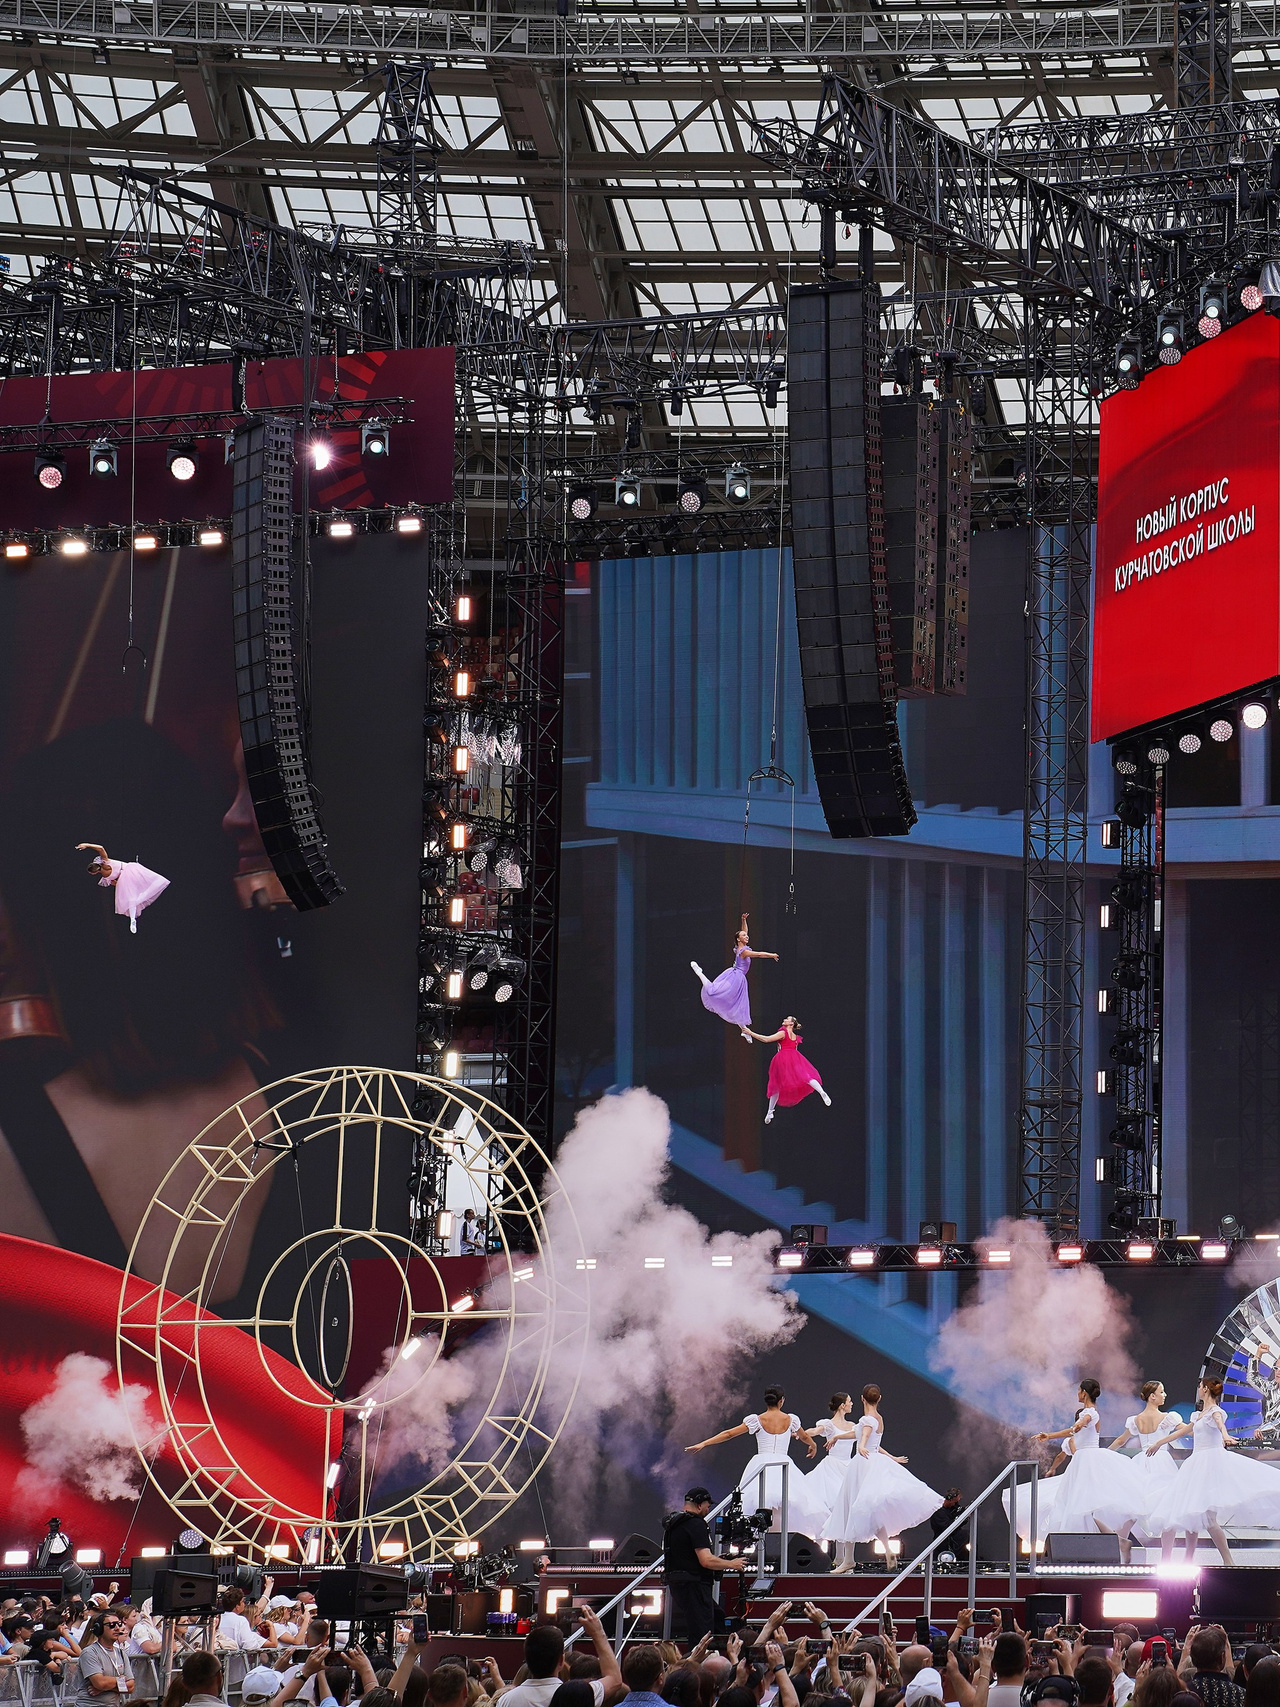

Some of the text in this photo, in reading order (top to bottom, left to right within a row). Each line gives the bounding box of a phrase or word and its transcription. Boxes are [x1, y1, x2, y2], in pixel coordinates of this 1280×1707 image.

[1114, 504, 1256, 593] КУРЧАТОВСКОЙ ШКОЛЫ
[1135, 476, 1230, 544] НОВЫЙ КОРПУС
